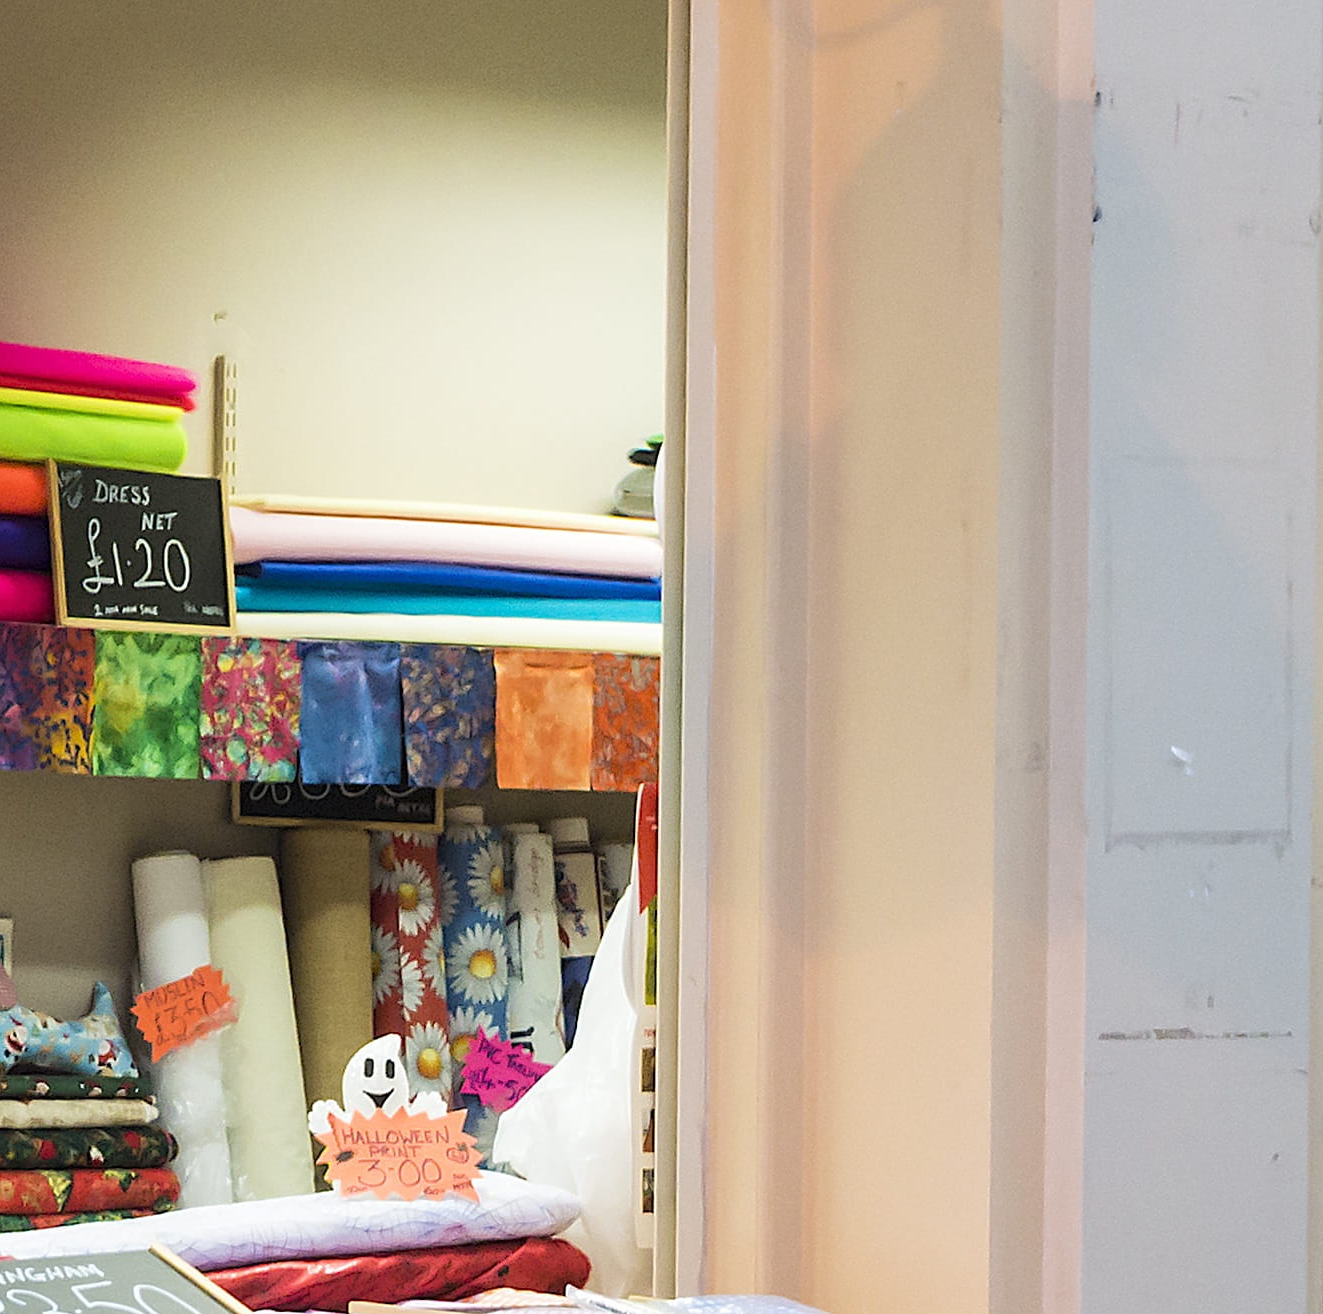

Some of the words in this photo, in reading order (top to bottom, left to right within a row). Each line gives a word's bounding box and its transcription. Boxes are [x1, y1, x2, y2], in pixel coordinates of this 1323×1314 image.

[92, 479, 152, 506] DRESS
[141, 511, 178, 531] NET
[342, 1125, 451, 1145] HALLOWEEN
[368, 1145, 423, 1158] PRINT
